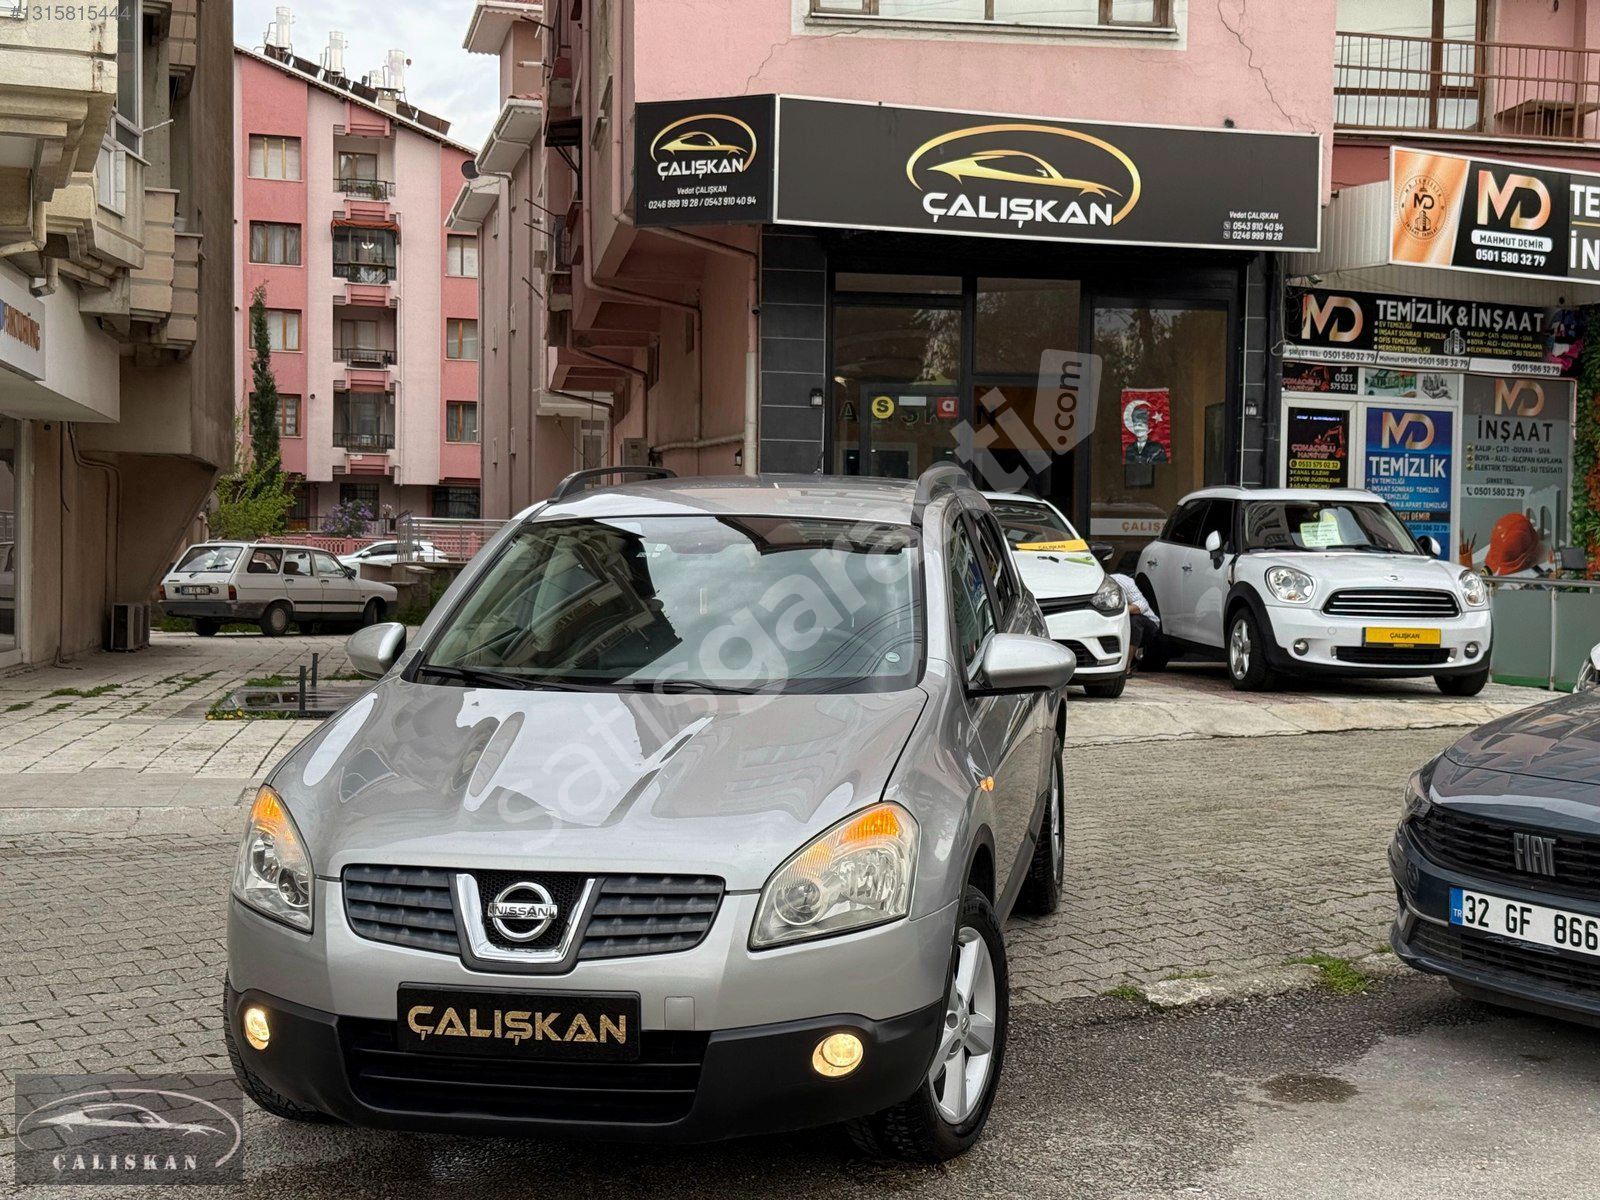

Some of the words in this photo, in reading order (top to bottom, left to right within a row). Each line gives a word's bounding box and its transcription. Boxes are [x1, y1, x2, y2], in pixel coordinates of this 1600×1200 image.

[657, 158, 744, 181] ÇALIŞKAN
[695, 185, 727, 195] ÇALIŞKAN
[648, 201, 666, 209] 0246
[667, 200, 680, 208] 999
[682, 199, 688, 208] 19
[689, 199, 698, 207] 28
[704, 197, 722, 206] 0543
[723, 197, 735, 206] 910
[736, 197, 746, 205] 40
[746, 196, 757, 205] 94
[1413, 192, 1435, 210] MD
[1476, 170, 1551, 231] MD
[922, 191, 1113, 229] ÇALIŞKAN
[1229, 211, 1246, 219] Vedat
[1247, 211, 1279, 220] ÇALIŞKAN
[1232, 221, 1251, 230] 0543
[1251, 222, 1263, 231] 910
[1264, 222, 1274, 231] 40
[1274, 222, 1284, 231] 94
[1232, 231, 1251, 240] 0246
[1251, 231, 1265, 240] 999
[1265, 232, 1273, 240] 19
[1273, 232, 1283, 241] 28
[1479, 234, 1517, 247] MAHMUT
[1517, 238, 1544, 250] DEMİR
[1476, 249, 1499, 262] 0501
[1501, 251, 1519, 264] 580
[1520, 253, 1532, 266] 32
[1533, 254, 1546, 267] 79
[1301, 293, 1364, 343] MD
[1376, 298, 1454, 325] TEMİZLİK
[1456, 306, 1469, 326] &
[1471, 303, 1544, 333] İNŞAAT
[1323, 350, 1340, 360] 0501
[1341, 351, 1355, 361] 580
[1356, 353, 1365, 362] 32
[1366, 353, 1376, 363] 79
[1419, 356, 1435, 366] 0501
[1450, 358, 1459, 367] 32
[1460, 359, 1468, 368] 79
[1512, 363, 1528, 373] 0501
[1543, 365, 1551, 374] 32
[1551, 366, 1560, 375] 79
[1334, 373, 1353, 383] 0533
[1341, 383, 1349, 391] 02
[1382, 412, 1435, 450] MD
[1477, 415, 1554, 443] İNŞAAT
[1369, 453, 1446, 478] TEMİZLİK
[1473, 487, 1491, 496] 0501
[1492, 488, 1506, 497] 580
[1506, 488, 1516, 497] 32
[1516, 489, 1525, 498] 79
[1513, 832, 1557, 877] FIAT
[494, 905, 549, 917] NISSAN
[1453, 908, 1463, 918] TR
[1464, 895, 1490, 928] 32
[1505, 904, 1533, 935] GF
[1553, 914, 1599, 951] 866
[407, 1004, 627, 1046] ÇALIŞKAN
